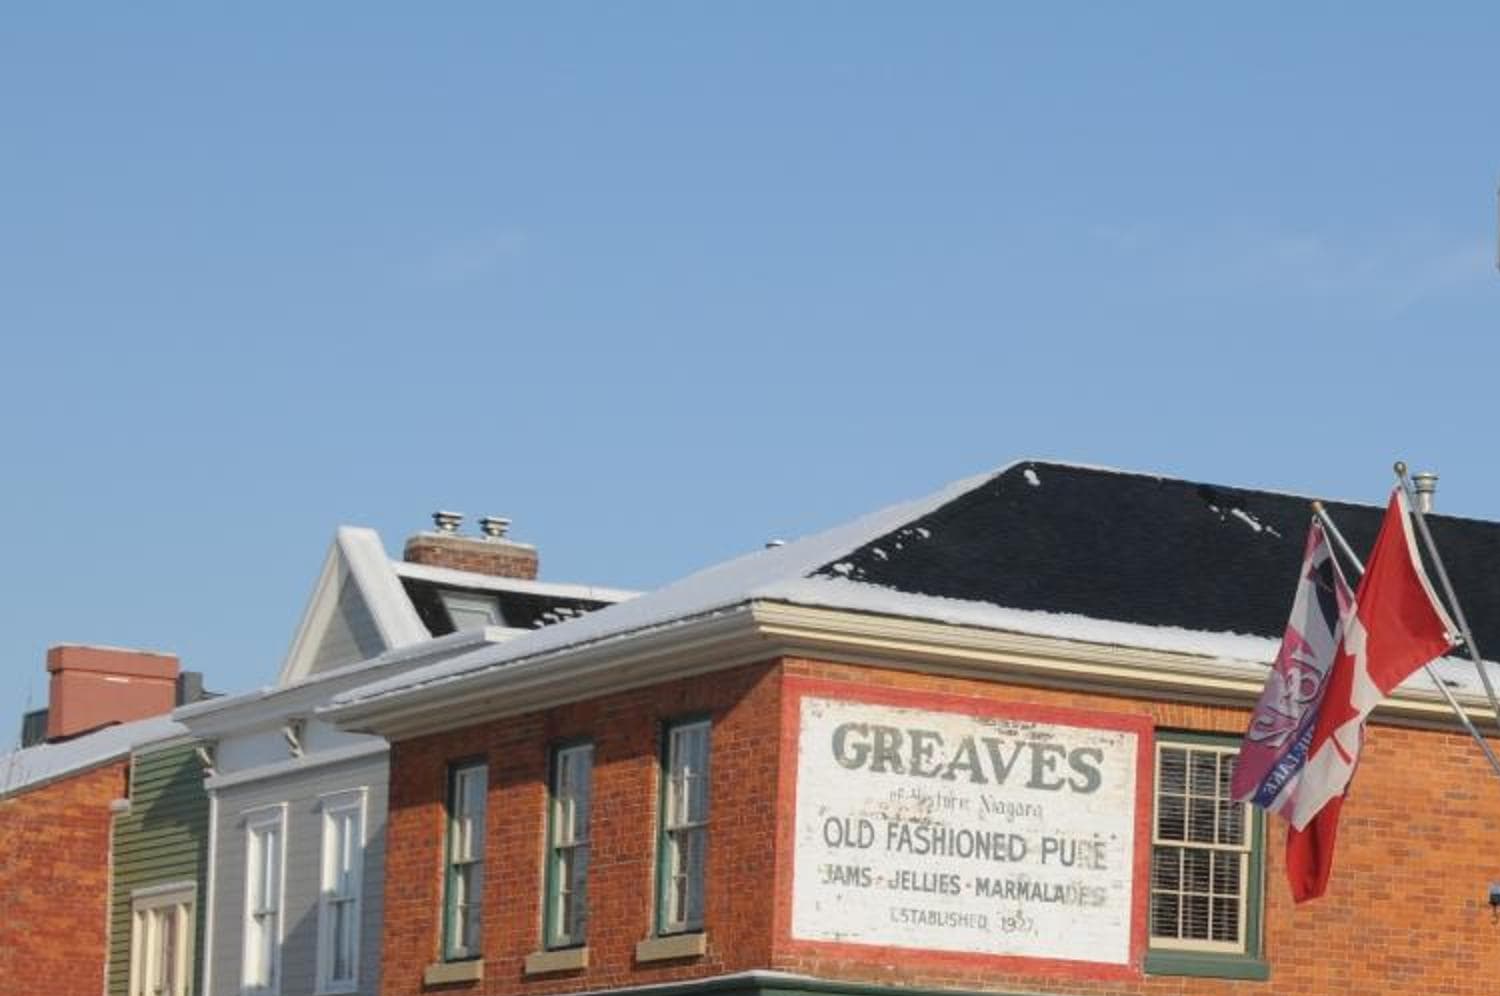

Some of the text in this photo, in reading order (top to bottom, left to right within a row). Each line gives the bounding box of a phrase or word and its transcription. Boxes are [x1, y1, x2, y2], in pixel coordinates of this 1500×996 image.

[831, 721, 1105, 795] GREAVES
[979, 793, 1044, 823] Niagara
[823, 816, 875, 849] OLD
[886, 821, 1027, 863] FASHIONED
[887, 869, 961, 895] JELLIES
[975, 876, 1106, 907] MARMALADES
[889, 906, 988, 929] ESTABLISHED
